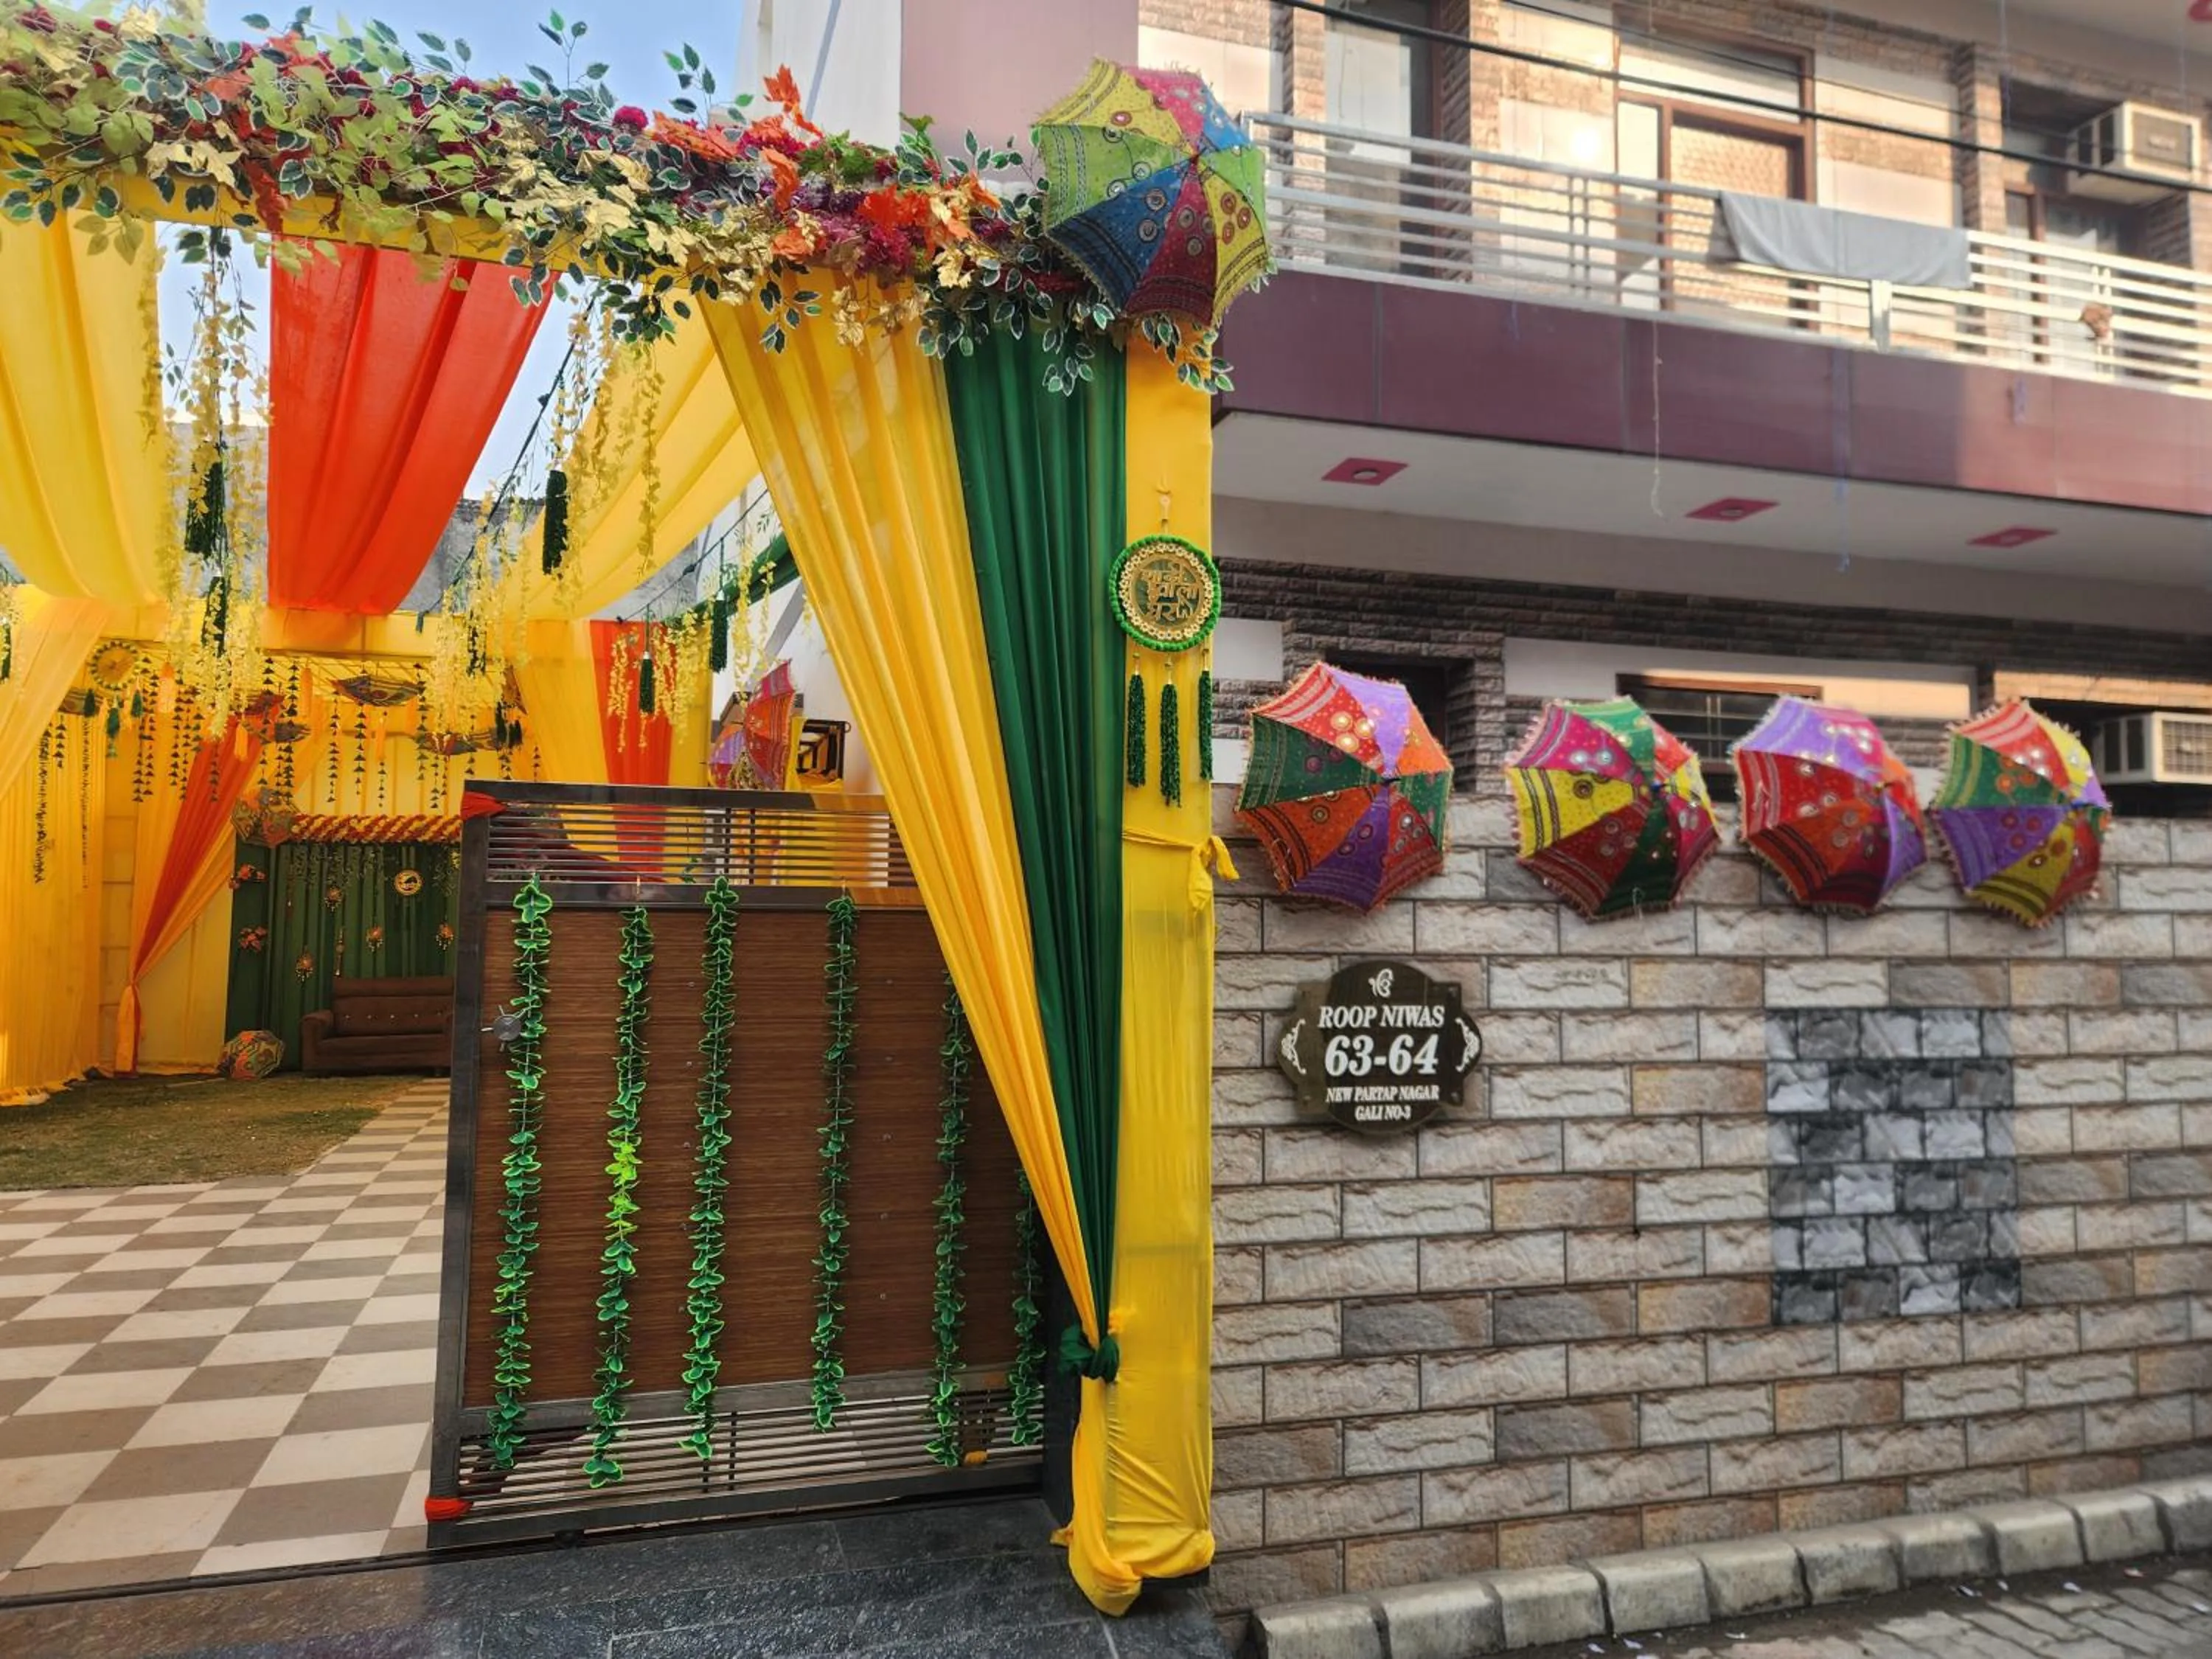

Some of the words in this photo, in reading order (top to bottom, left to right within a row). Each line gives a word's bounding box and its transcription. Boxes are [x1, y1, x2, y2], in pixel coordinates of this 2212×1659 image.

[1318, 1006, 1377, 1029] ROOP
[1380, 1005, 1445, 1028] NIWAS
[1325, 1034, 1439, 1076] 63-64
[1326, 1087, 1352, 1102] NEW
[1354, 1085, 1398, 1102] PARTAP
[1399, 1085, 1439, 1101] NAGAR
[1355, 1105, 1383, 1121] GALI
